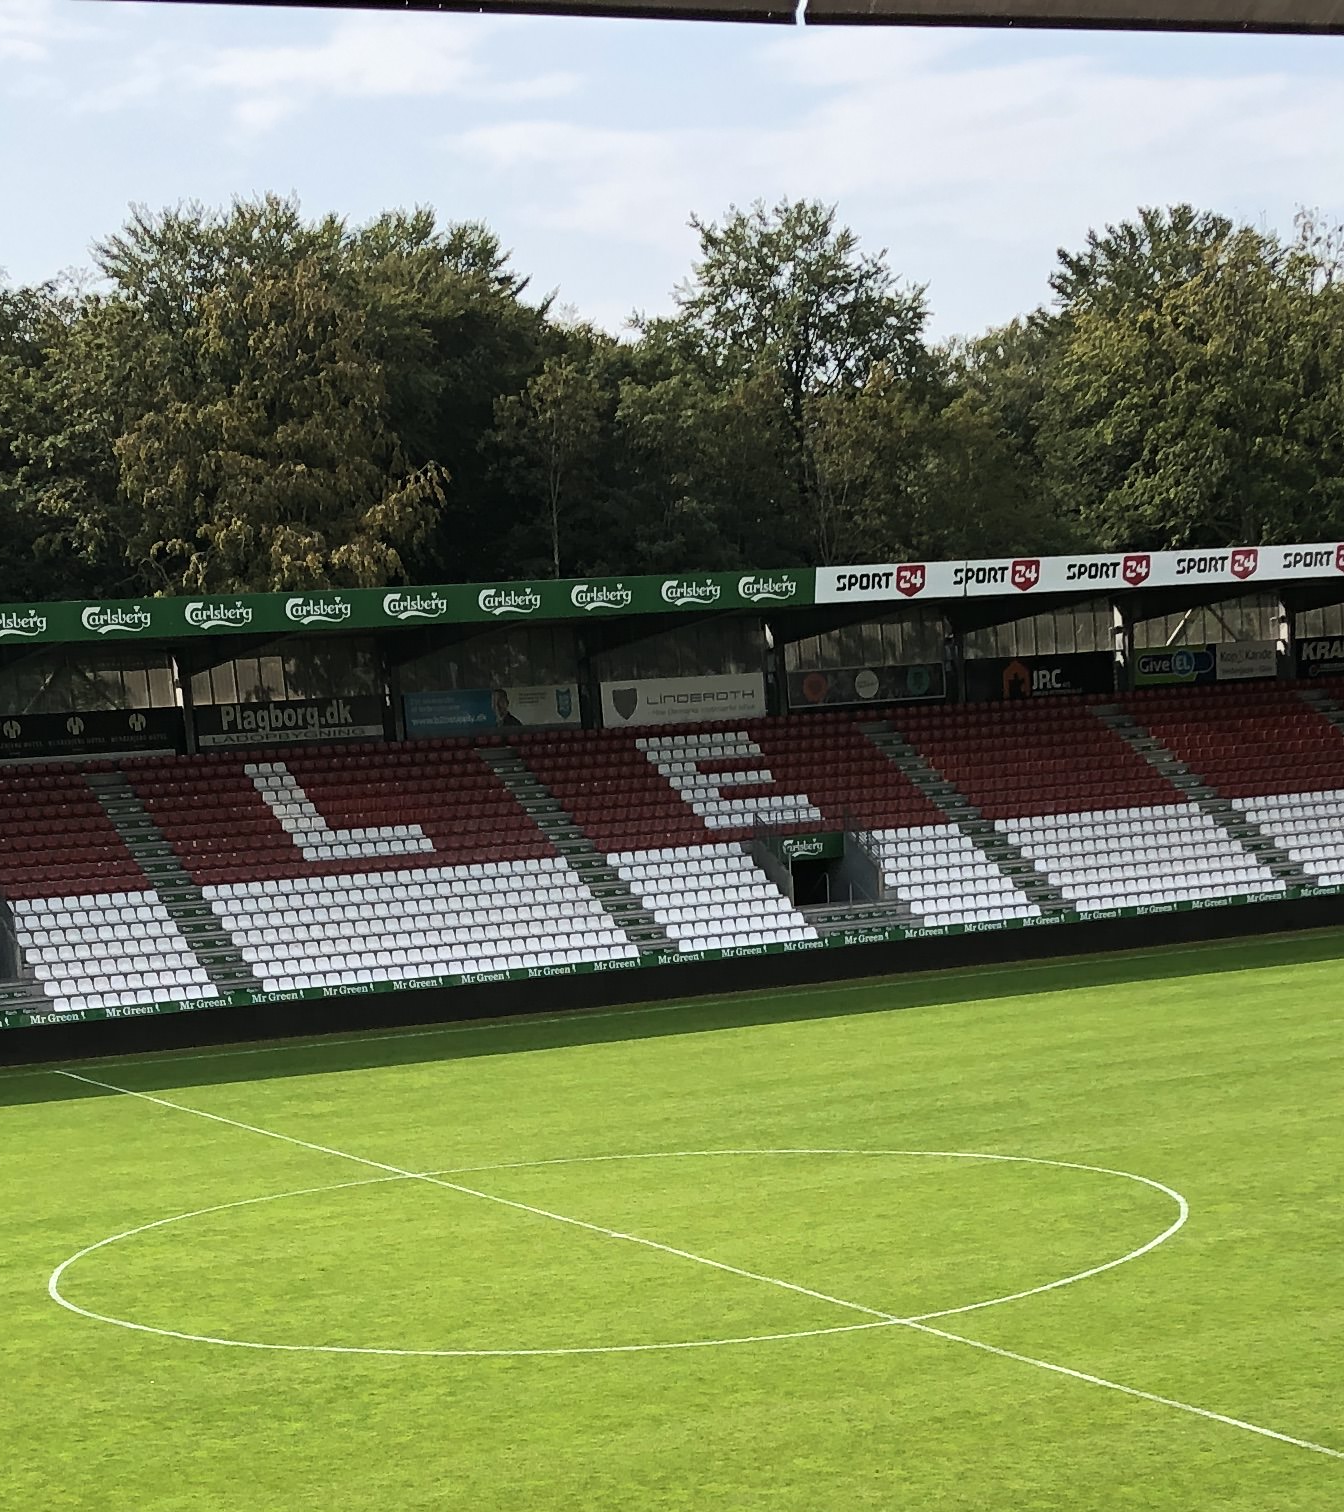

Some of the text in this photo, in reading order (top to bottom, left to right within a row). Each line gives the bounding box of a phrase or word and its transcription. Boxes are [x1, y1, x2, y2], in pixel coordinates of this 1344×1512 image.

[1066, 560, 1148, 581] SPORT 24
[1176, 554, 1256, 575] SPORT 24
[1283, 551, 1335, 569] SPORT
[836, 570, 923, 592] SPORT 24
[953, 564, 1038, 586] SPORT 24
[570, 583, 632, 611] Carlsberg
[661, 579, 721, 606] Carlsberg
[738, 575, 796, 602] Carlsberg
[285, 597, 351, 624] Carlsberg
[383, 592, 447, 620] Carlsberg
[478, 588, 541, 615] Carlsberg
[81, 606, 151, 634] Carlsberg
[184, 601, 252, 629] Carlsberg
[1139, 656, 1190, 674] Give EL
[1032, 669, 1062, 691] JRC
[220, 700, 353, 733] Plagborg.dk
[212, 727, 366, 745] LADOPBYGNING
[673, 953, 699, 962] Green
[409, 978, 437, 987] Green
[106, 1005, 153, 1017] Mr Green
